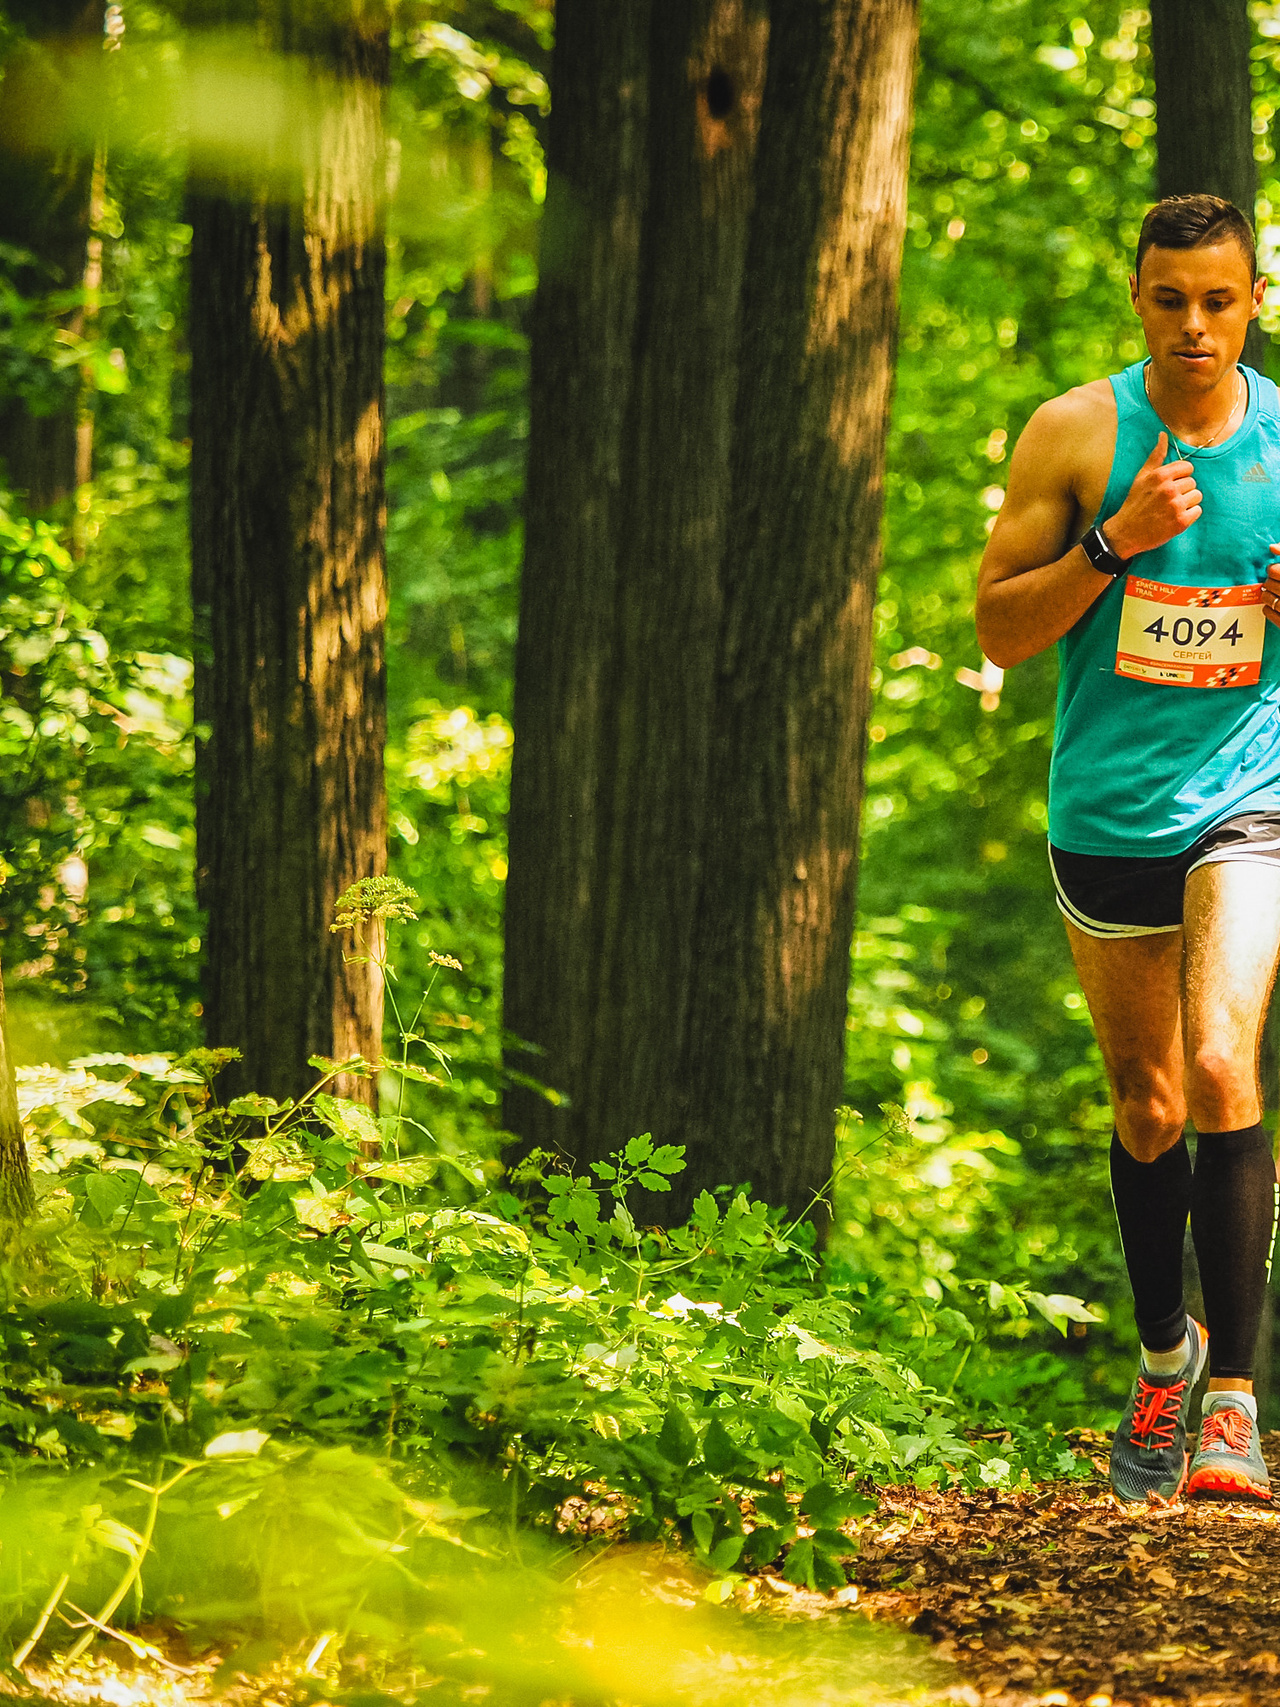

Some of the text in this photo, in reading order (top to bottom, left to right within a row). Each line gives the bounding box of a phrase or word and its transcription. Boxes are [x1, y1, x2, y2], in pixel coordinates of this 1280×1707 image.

[1135, 580, 1158, 591] SPACE
[1135, 587, 1154, 597] TRAIL
[1143, 616, 1243, 647] 4094
[1172, 650, 1212, 660] СЕРГЕЙ
